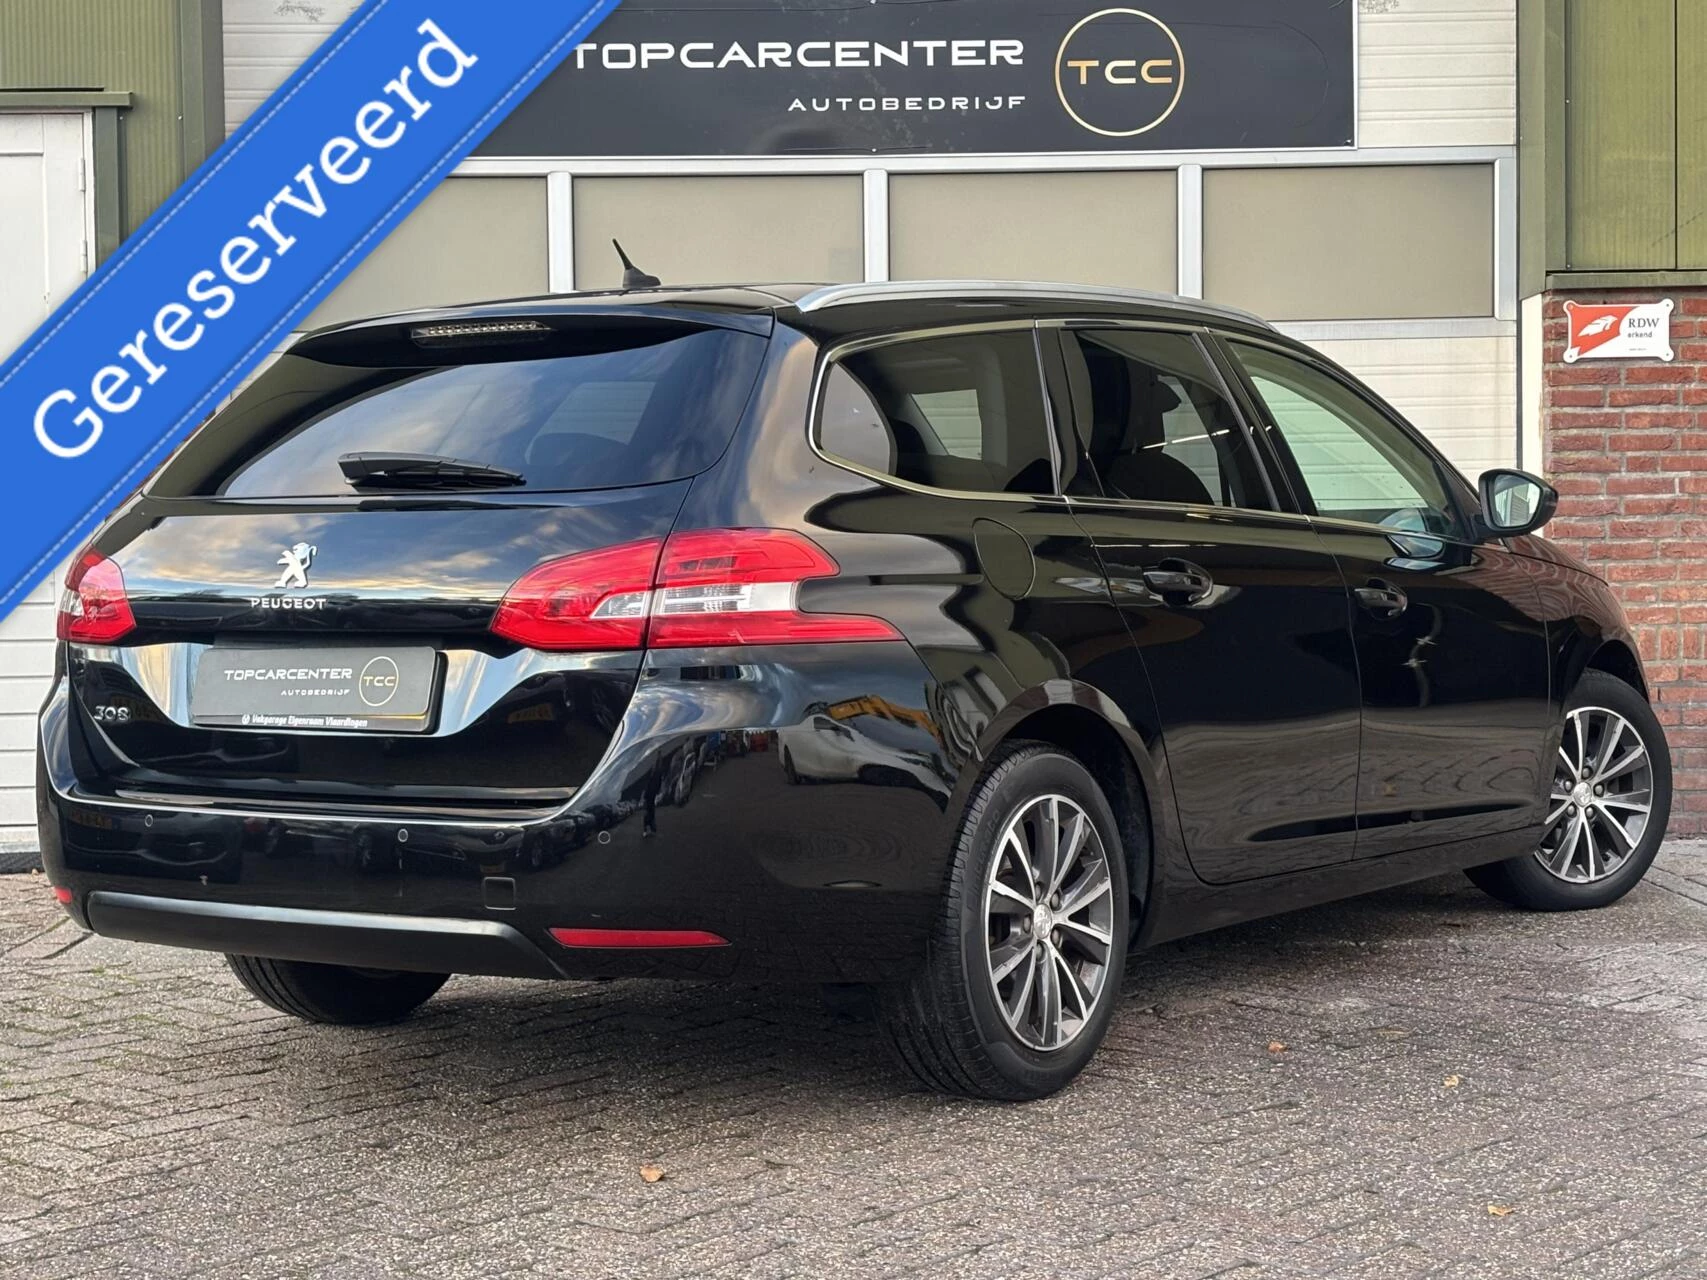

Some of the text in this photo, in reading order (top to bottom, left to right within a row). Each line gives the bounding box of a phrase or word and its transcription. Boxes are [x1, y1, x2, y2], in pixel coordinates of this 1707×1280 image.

[574, 39, 1025, 70] TOPCARCENTER
[1067, 59, 1173, 85] TCC
[787, 95, 1027, 112] AUTOBEDRIJF
[1627, 317, 1660, 329] RDW
[250, 597, 327, 610] PEUGEOT
[223, 668, 354, 681] TOPCARCENTER
[363, 675, 396, 687] TCC
[280, 688, 351, 697] AUTOBEDRIJF
[93, 705, 131, 721] 308
